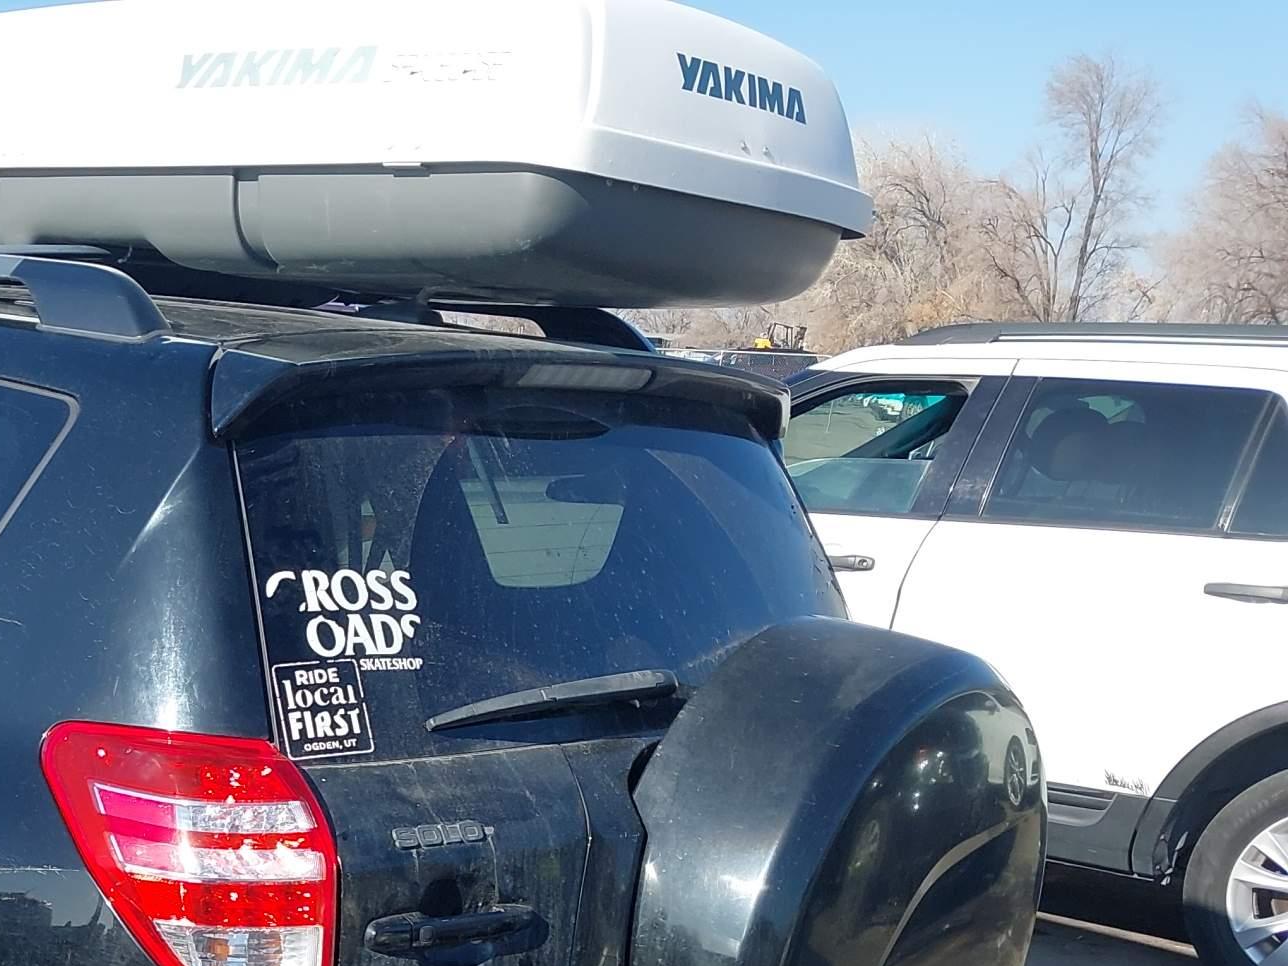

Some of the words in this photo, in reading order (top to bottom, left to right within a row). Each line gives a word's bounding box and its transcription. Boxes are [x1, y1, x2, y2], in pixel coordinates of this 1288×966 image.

[175, 45, 379, 89] YAKIMA
[675, 52, 807, 125] YAKIMA
[294, 667, 340, 686] RIDE
[360, 657, 424, 671] SKATESHOP
[282, 680, 358, 710] local
[288, 708, 362, 740] FIRST
[304, 741, 343, 752] OGDEN,
[344, 739, 358, 748] UT
